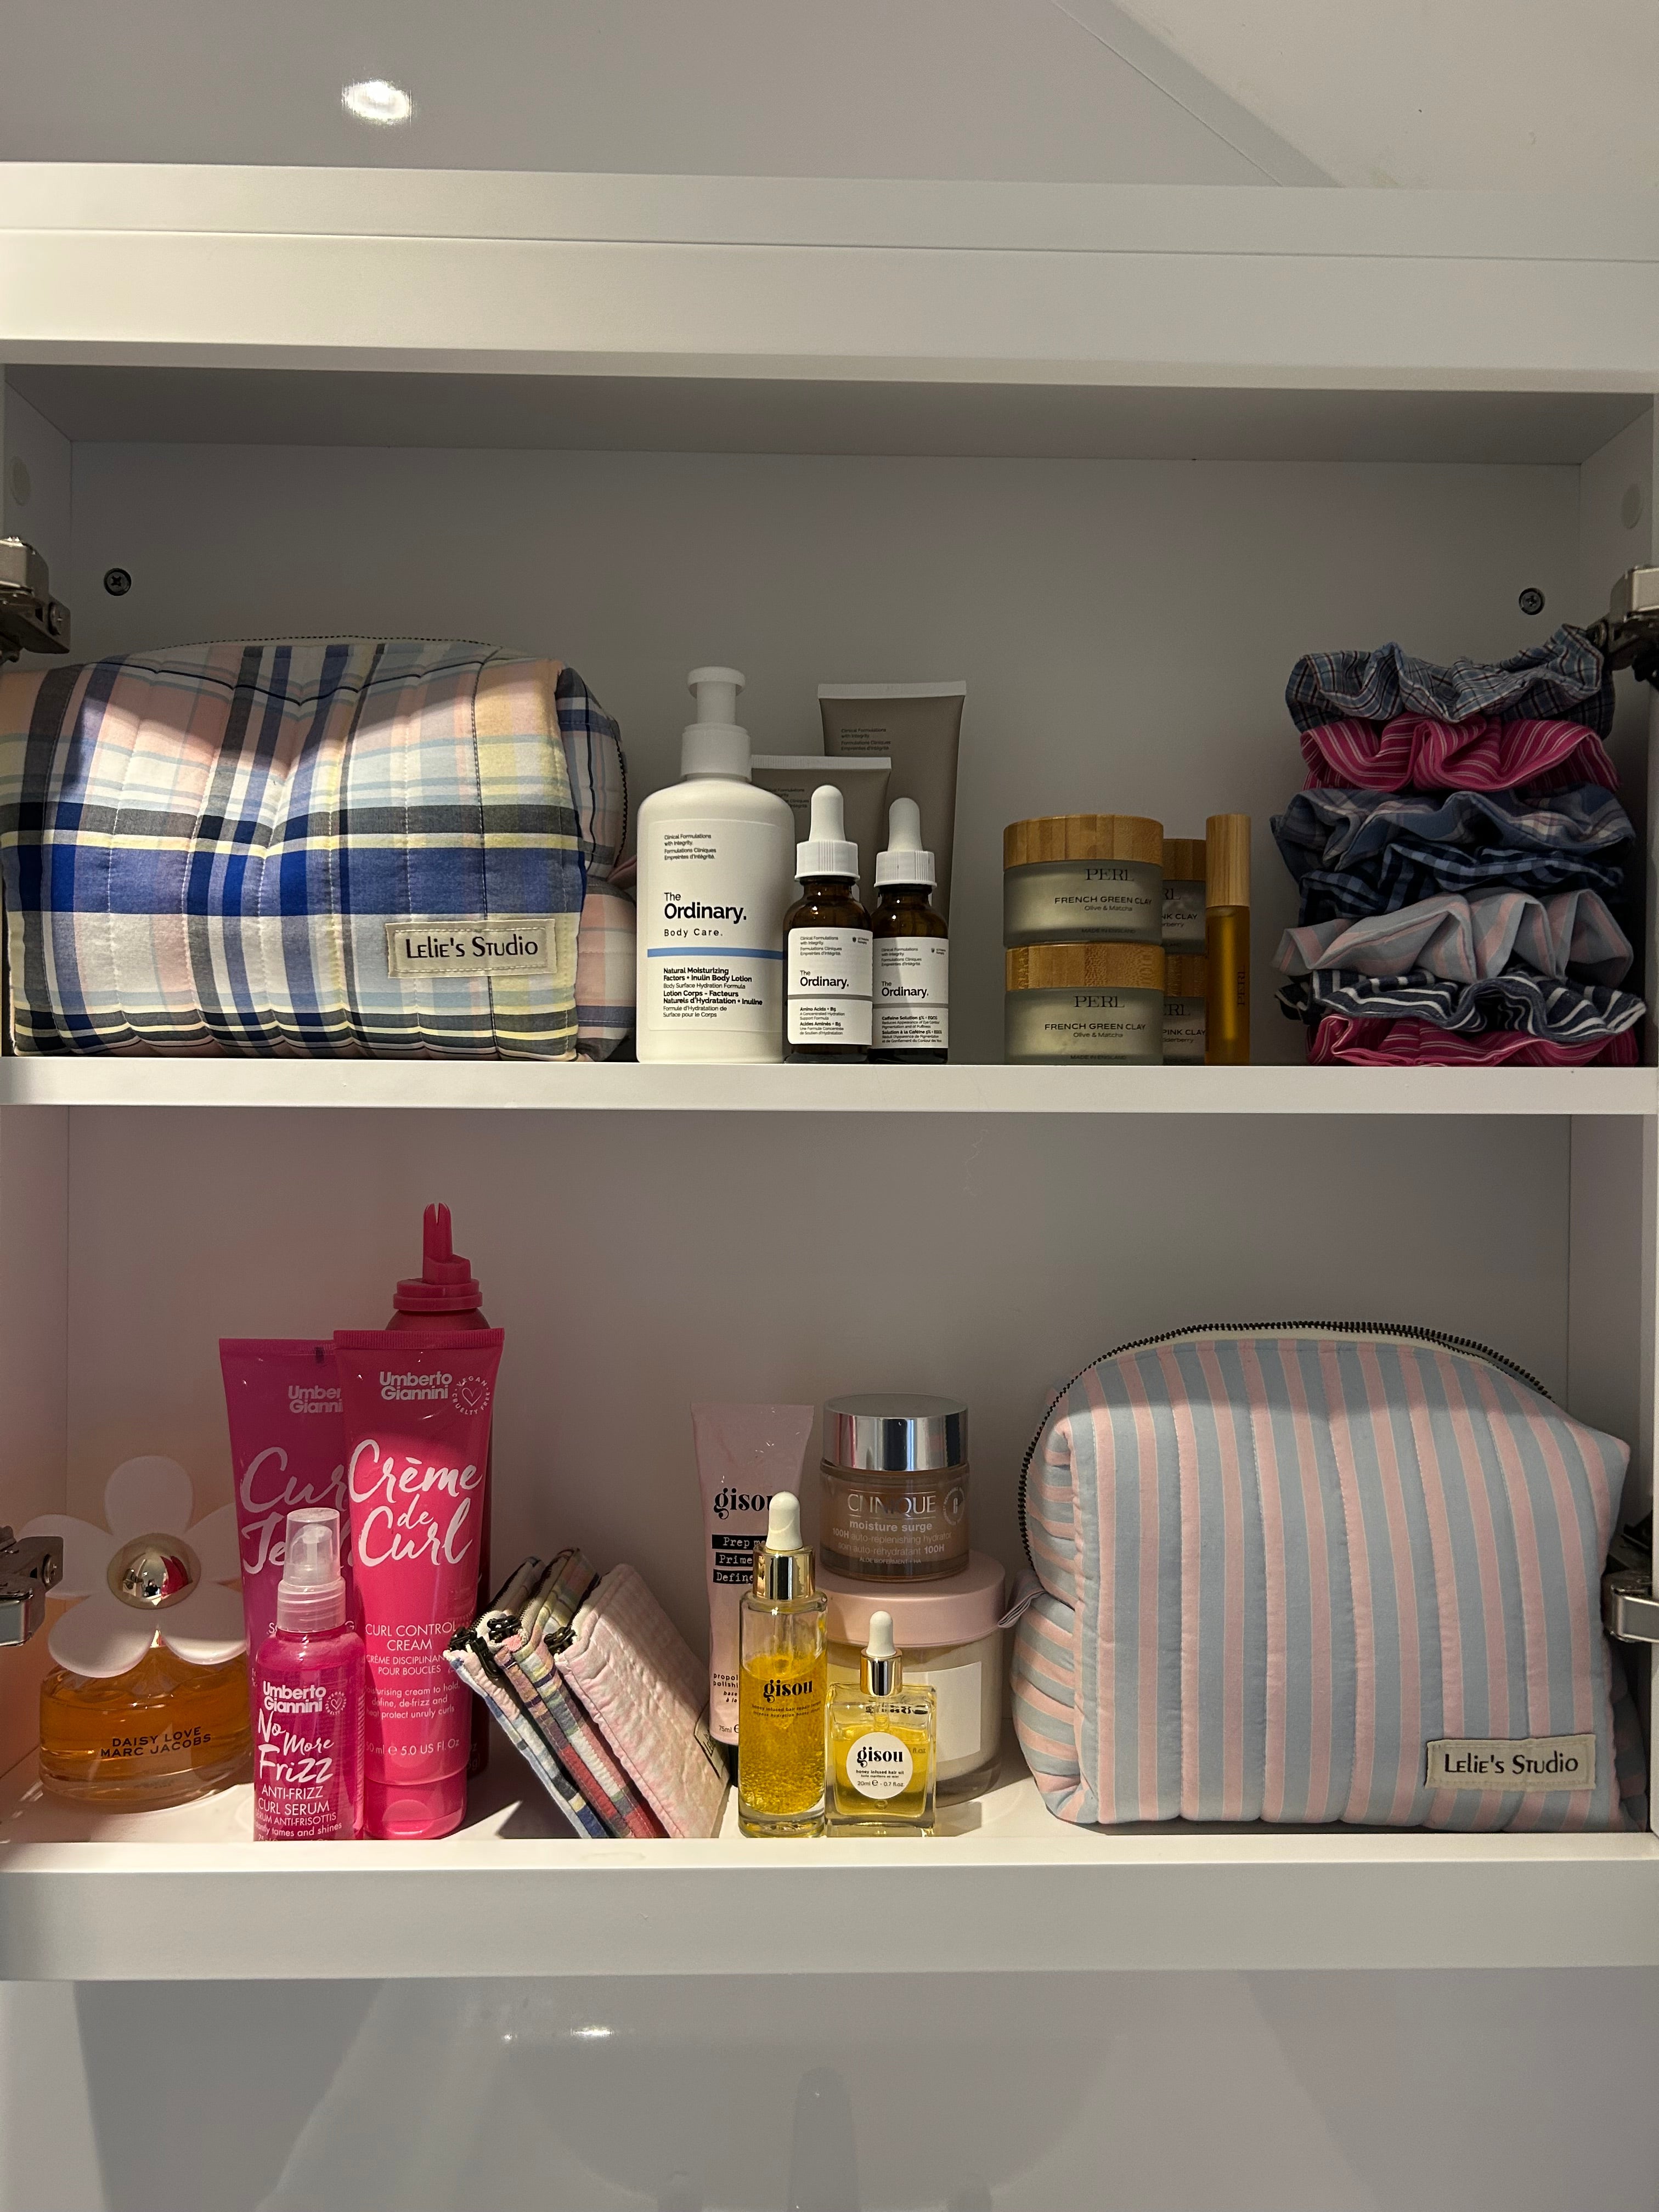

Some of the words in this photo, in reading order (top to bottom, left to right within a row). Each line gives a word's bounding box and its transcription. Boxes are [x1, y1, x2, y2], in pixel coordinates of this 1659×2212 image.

[1085, 869, 1134, 881] PERL
[664, 893, 681, 901] The
[1162, 888, 1180, 900] RL
[664, 902, 747, 924] Ordinary.
[664, 928, 688, 938] Body
[472, 934, 538, 957] Studio
[800, 977, 849, 989] Ordinary.
[882, 986, 928, 998] Ordinary.
[1073, 996, 1124, 1007] PERL
[380, 1372, 453, 1386] Umberto
[456, 1376, 487, 1386] VEGAN
[288, 1385, 341, 1400] Umber
[381, 1386, 448, 1401] Giannini
[289, 1400, 342, 1414] Gianni
[452, 1393, 478, 1415] CRUELTY
[481, 1392, 490, 1410] FREE
[348, 1439, 483, 1503] Crème
[240, 1447, 349, 1513] Cur
[397, 1493, 433, 1529] de
[847, 1493, 936, 1517] CLINIQUE
[359, 1498, 473, 1567] Curl
[850, 1521, 898, 1531] moisture
[901, 1523, 933, 1533] surge
[723, 1537, 749, 1549] Prep
[833, 1527, 849, 1539] 100H
[851, 1534, 921, 1545] auto-replenishing
[923, 1531, 952, 1542] hydrator
[838, 1542, 851, 1551] soin
[853, 1545, 921, 1555] auto-réhydratant
[924, 1544, 945, 1554] 100H
[719, 1555, 752, 1564] Prime
[716, 1572, 753, 1583] Define
[365, 1623, 392, 1637] CURL
[396, 1622, 456, 1637] CONTROL
[387, 1639, 432, 1651] CREAM
[366, 1654, 390, 1664] CRÈME
[393, 1654, 446, 1664] DISCIPLINAN
[379, 1667, 400, 1675] POUR
[403, 1665, 441, 1675] BOUCLES
[263, 1680, 326, 1700] Umberto
[366, 1686, 402, 1698] oisturising
[764, 1679, 812, 1703] gisou
[264, 1696, 323, 1713] Giannini
[372, 1699, 396, 1708] define,
[399, 1699, 430, 1707] de-frizz
[433, 1695, 448, 1704] and
[366, 1708, 379, 1717] heat
[411, 1709, 436, 1718] unruly
[438, 1705, 454, 1714] curls
[258, 1708, 286, 1743] No
[112, 1735, 158, 1747] DAISY
[165, 1726, 201, 1742] LOVE
[283, 1732, 334, 1756] More
[101, 1747, 144, 1757] MARC
[150, 1734, 211, 1754] JACOBS
[366, 1742, 374, 1751] 50
[401, 1746, 416, 1756] 5.0
[420, 1745, 433, 1754] US
[448, 1739, 459, 1748] Oz
[857, 1747, 902, 1768] gisou
[1513, 1751, 1578, 1774] Studio
[262, 1784, 323, 1800] ANTI-FRIZZ
[258, 1798, 280, 1814] CURL
[285, 1801, 330, 1815] SERUM
[274, 1812, 337, 1826] ANTI-FRISOTTIS
[272, 1827, 294, 1837] tames
[297, 1827, 314, 1836] and
[318, 1822, 342, 1835] shines
